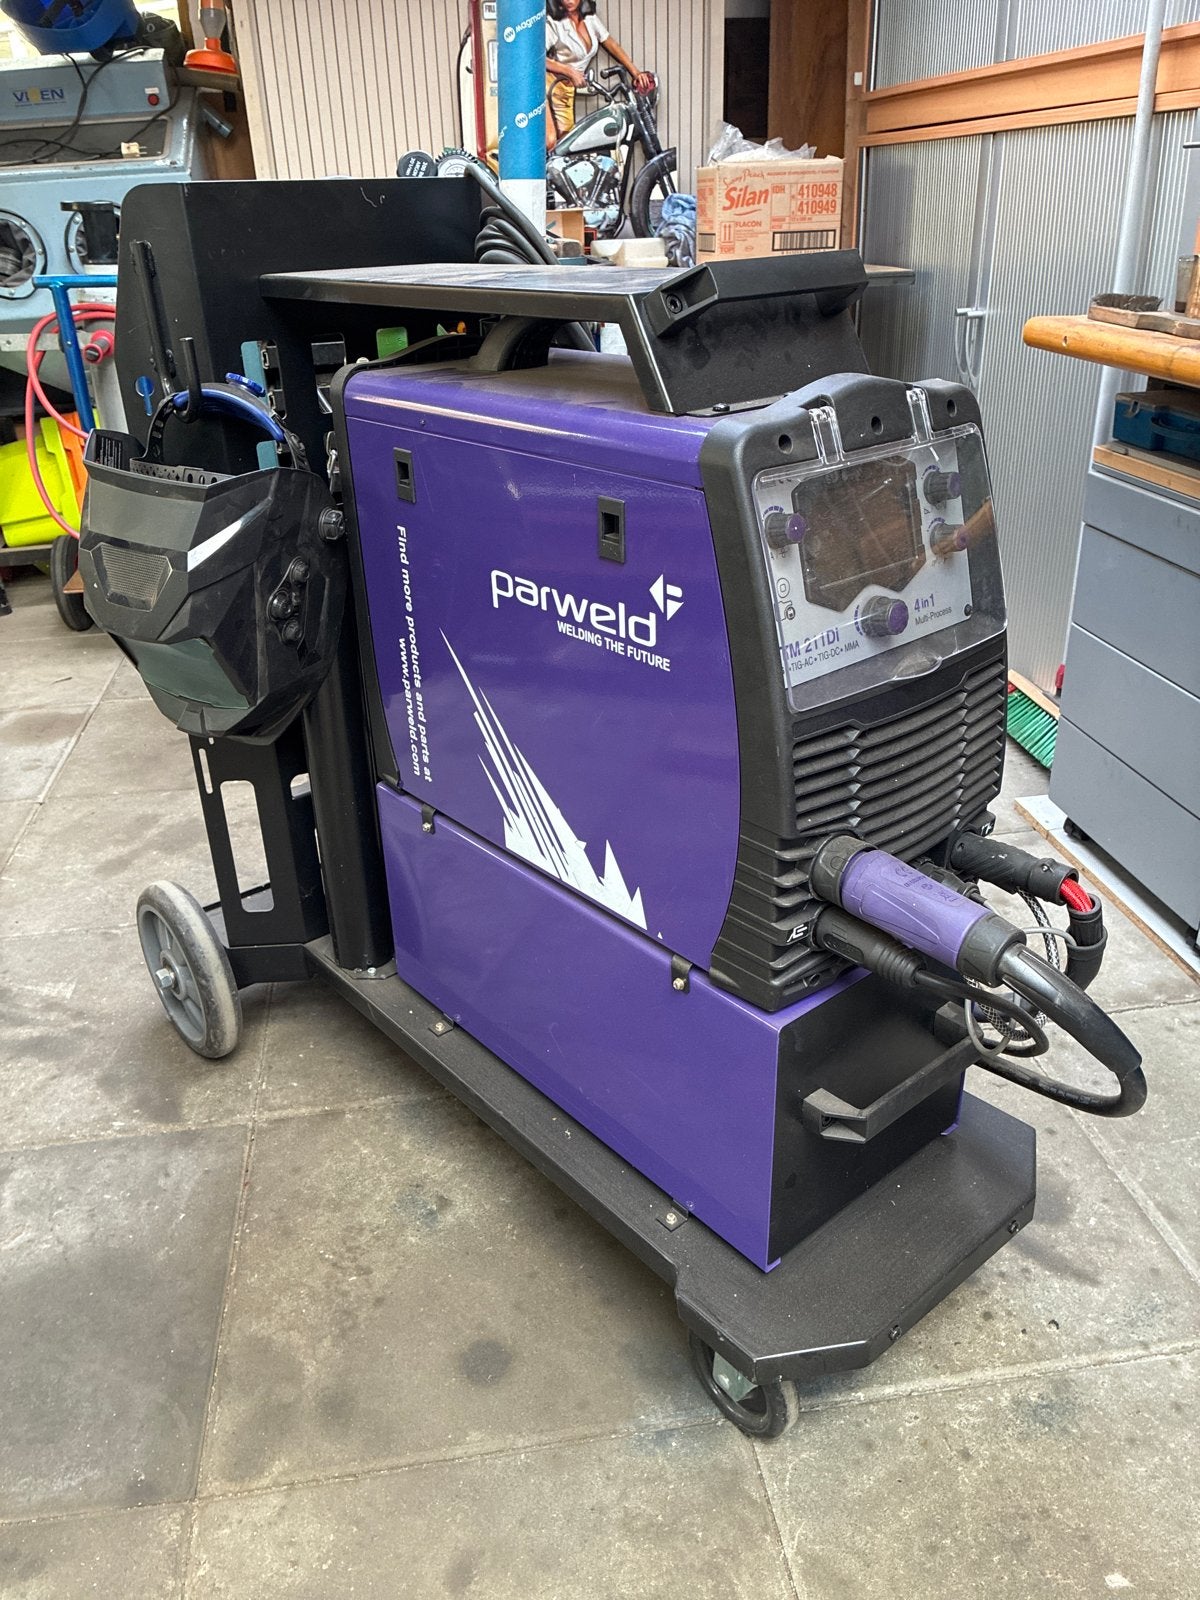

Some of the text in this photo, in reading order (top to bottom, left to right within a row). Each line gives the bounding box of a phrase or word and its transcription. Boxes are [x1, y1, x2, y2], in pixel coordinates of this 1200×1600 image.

[13, 88, 64, 103] VIEN
[722, 185, 769, 211] Silan
[798, 183, 838, 199] 410948
[798, 199, 837, 215] 410949
[490, 569, 657, 647] parweld
[914, 593, 935, 612] 4 in 1
[397, 525, 433, 782] Find more products and parts at
[557, 620, 671, 672] WELDING THE FUTURE
[783, 640, 801, 660] TM
[399, 638, 420, 776] www.parweld.com
